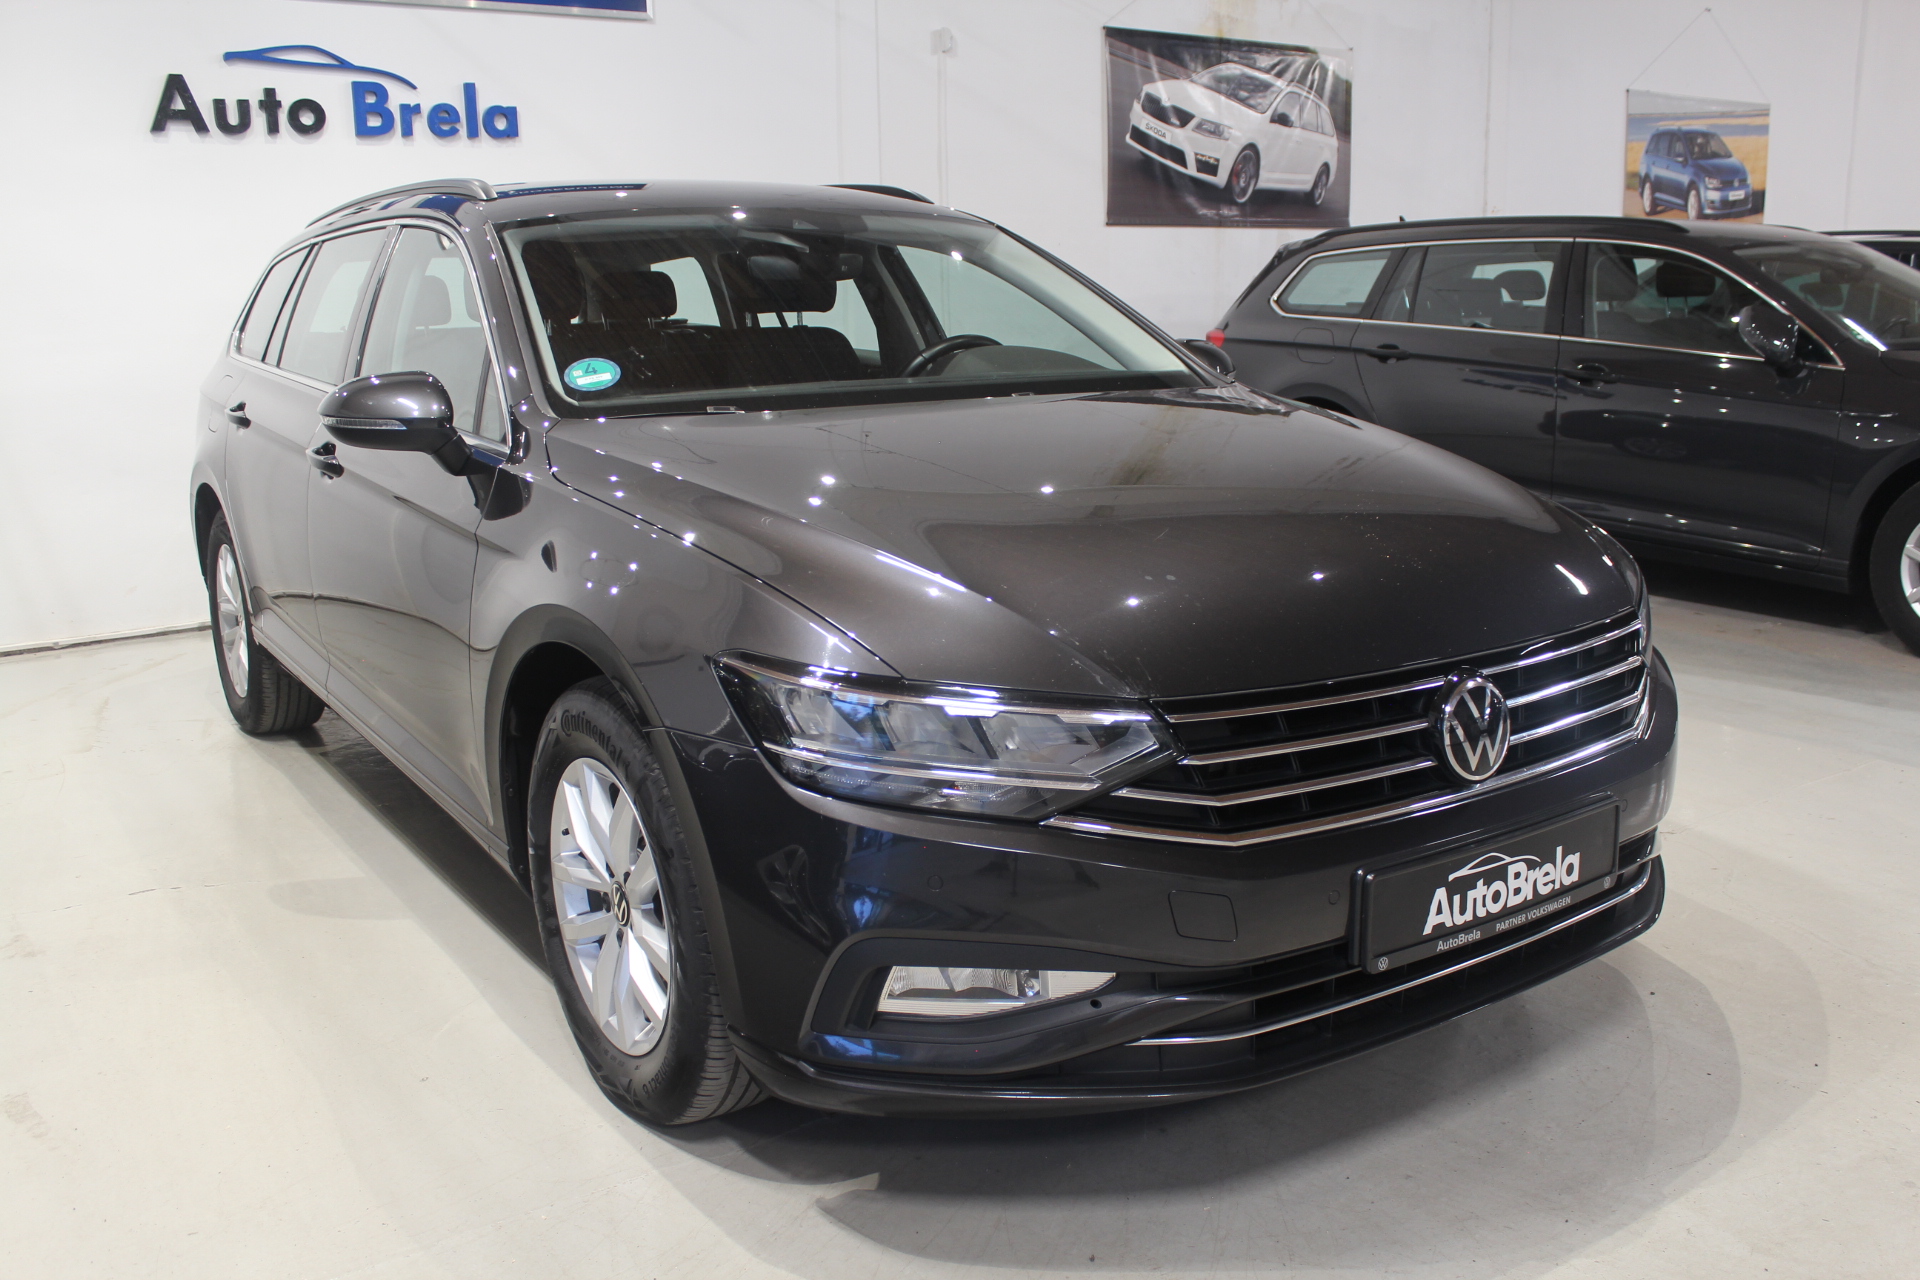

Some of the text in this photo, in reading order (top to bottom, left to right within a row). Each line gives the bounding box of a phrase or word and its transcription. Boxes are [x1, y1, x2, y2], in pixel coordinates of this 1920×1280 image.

[150, 73, 519, 139] Auto Brela
[584, 363, 598, 375] 4
[561, 709, 623, 769] Continental
[1422, 845, 1581, 936] AutoBrela
[1495, 896, 1571, 932] PARTNER VOLKSWAGEN
[1436, 930, 1481, 952] AutoBrela
